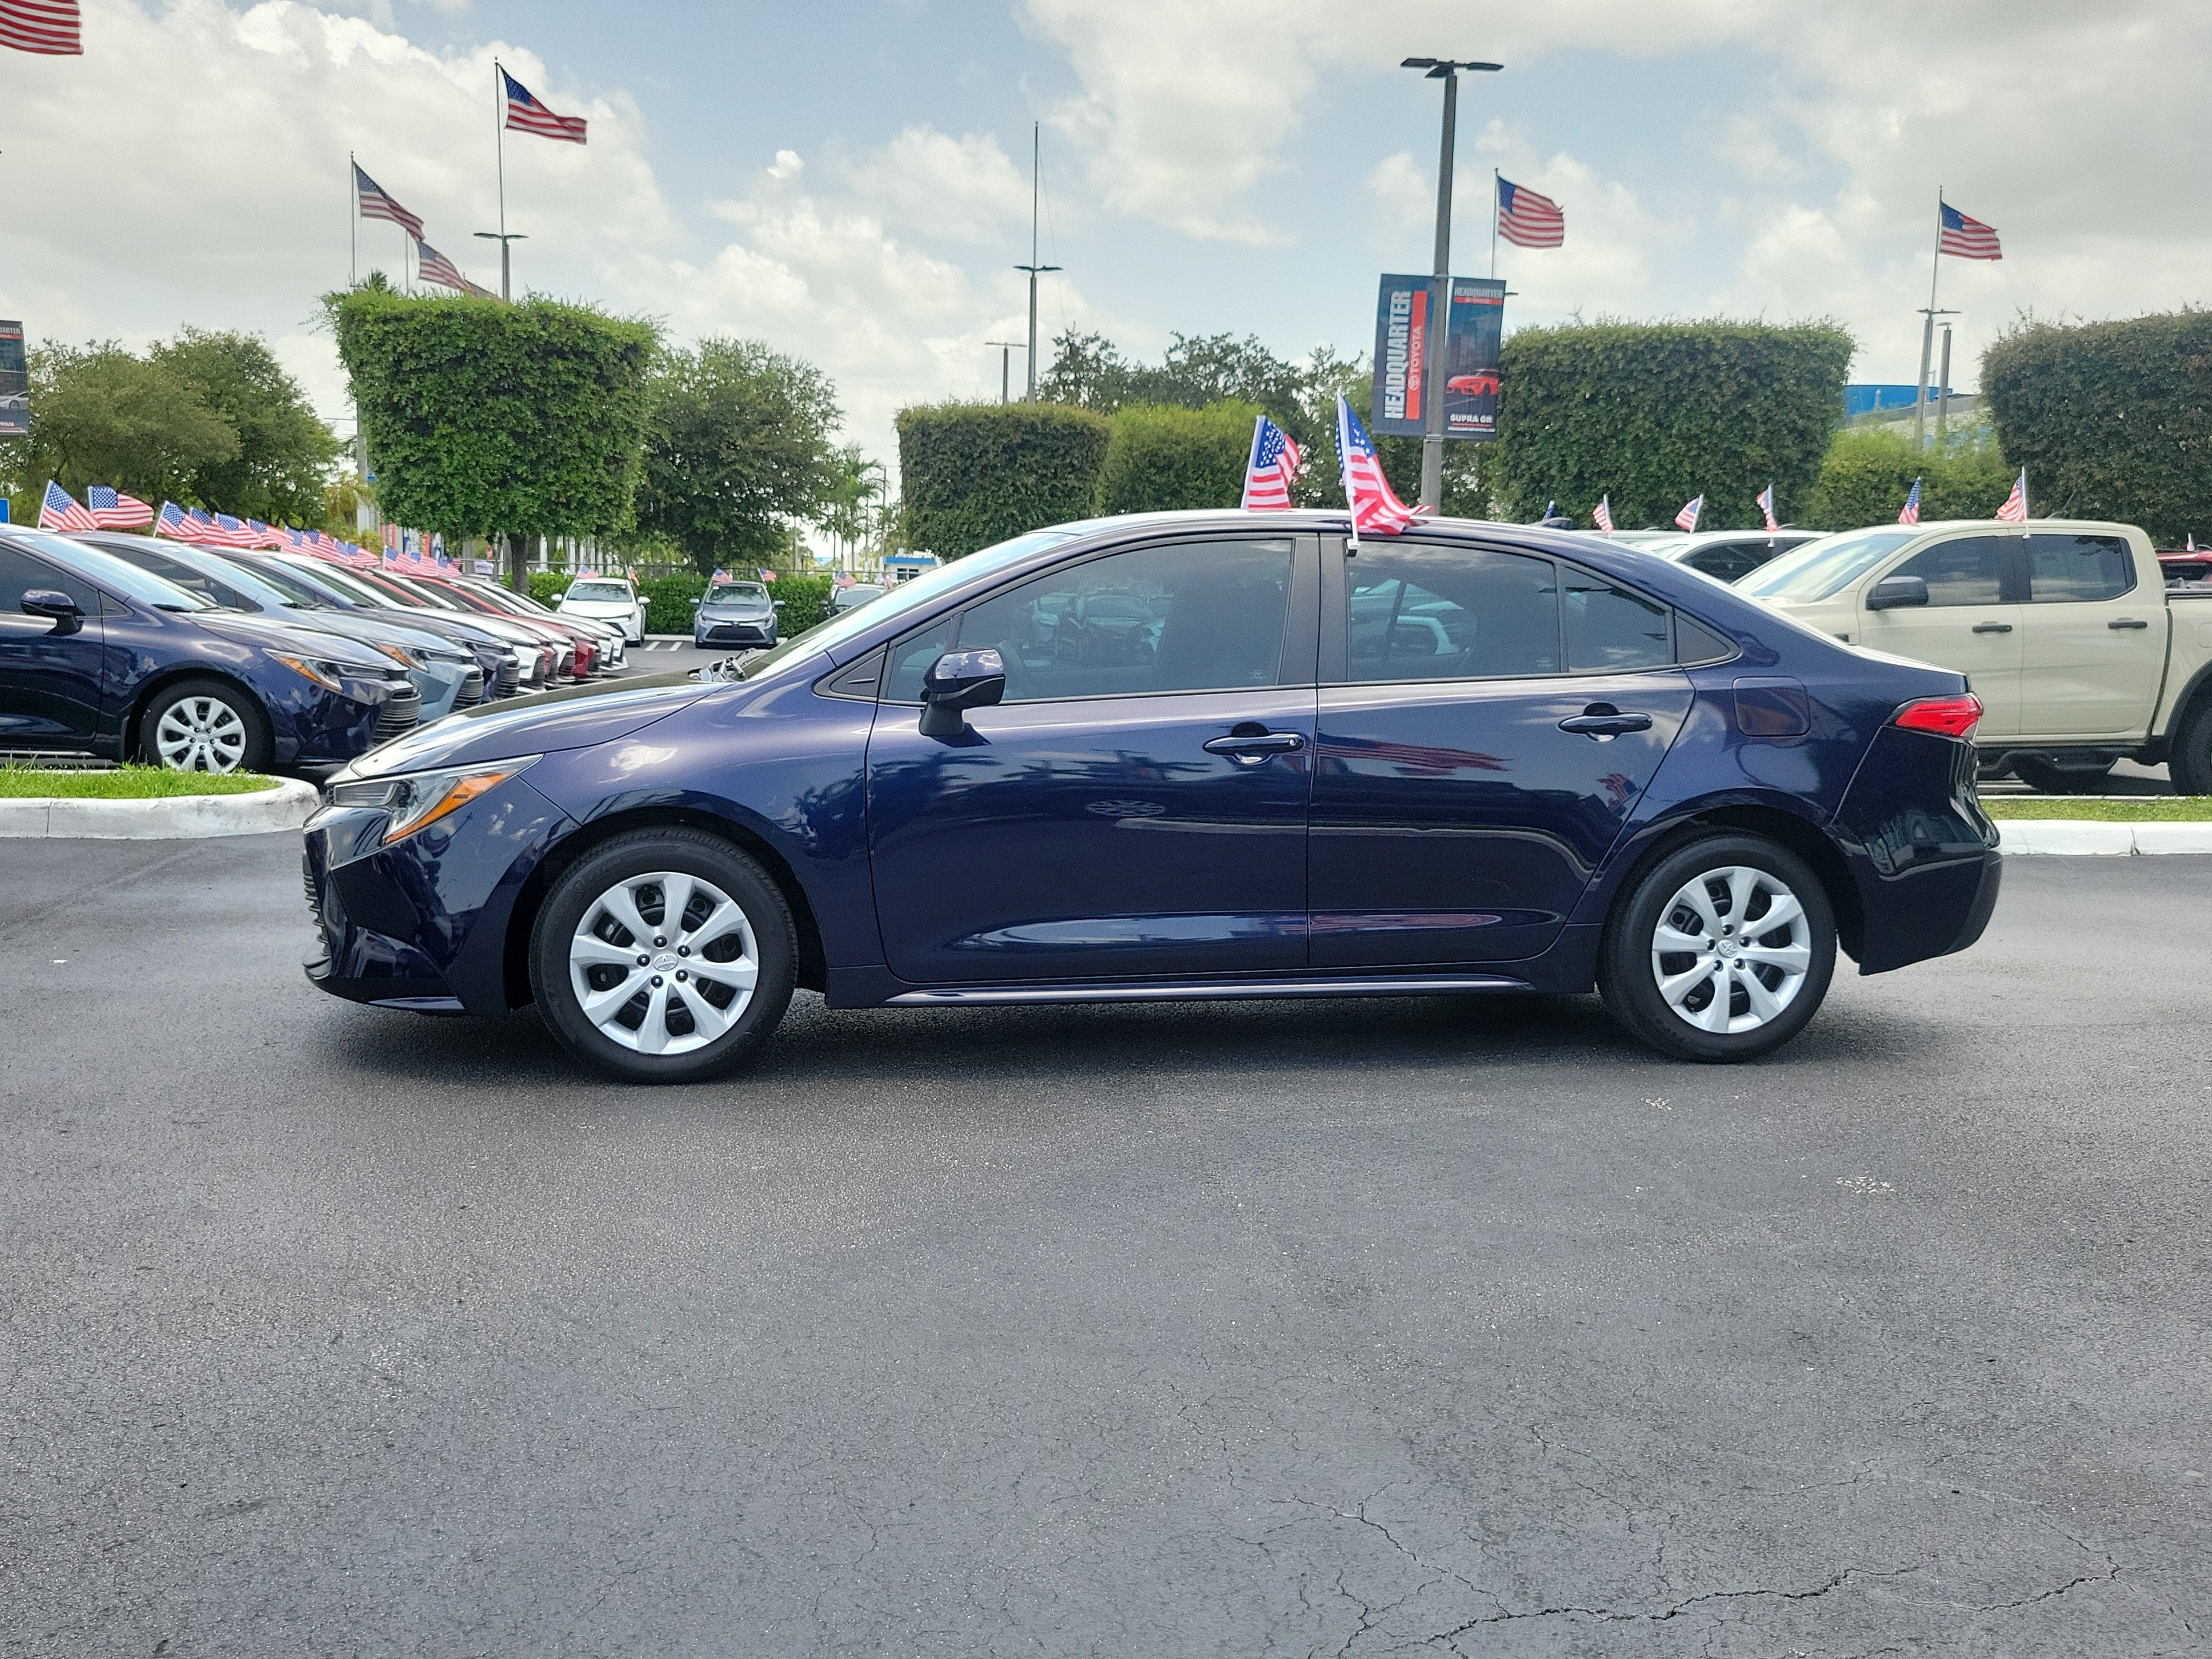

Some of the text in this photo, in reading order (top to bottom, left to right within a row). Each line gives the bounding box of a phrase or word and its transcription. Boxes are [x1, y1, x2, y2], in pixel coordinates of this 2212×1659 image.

[1384, 290, 1412, 419] HEADQUARTER
[1410, 326, 1422, 374] TOYOTA
[1450, 414, 1479, 423] SUPRA
